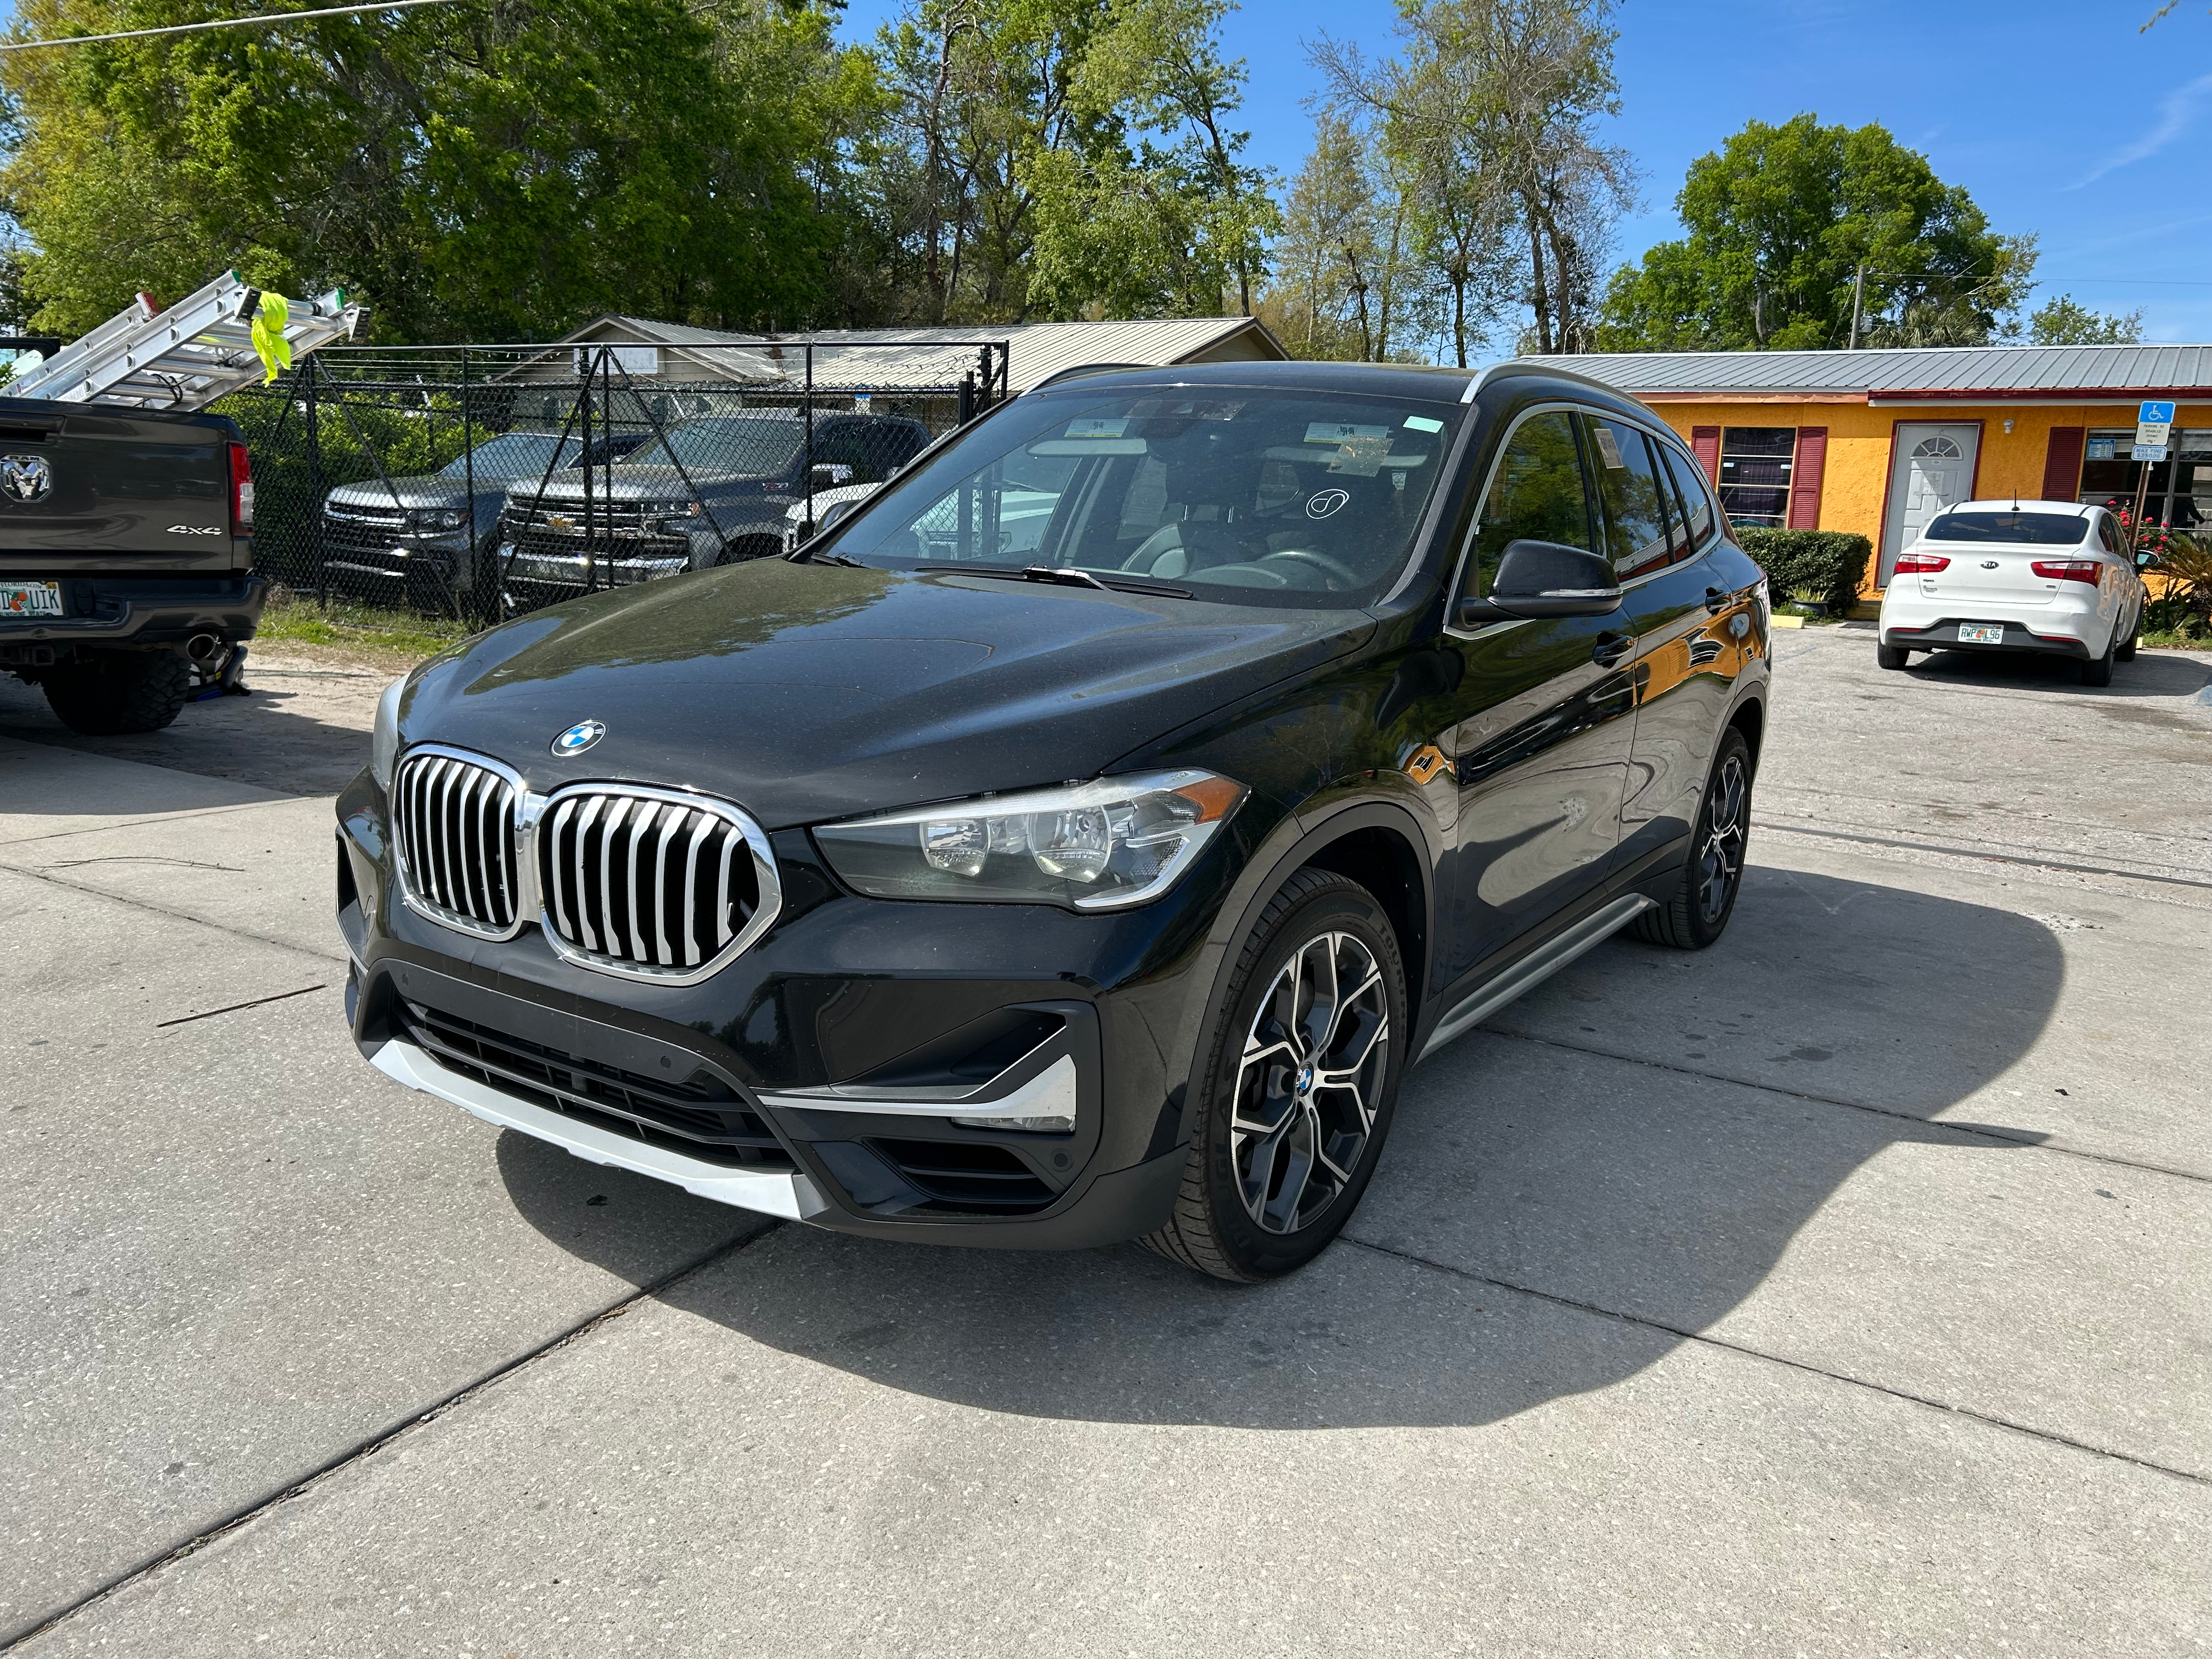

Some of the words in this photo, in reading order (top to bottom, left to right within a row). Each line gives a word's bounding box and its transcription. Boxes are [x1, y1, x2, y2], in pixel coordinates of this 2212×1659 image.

[29, 590, 59, 609] UIK
[1985, 629, 2001, 639] L96
[1213, 1055, 1251, 1250] DUGLAS
